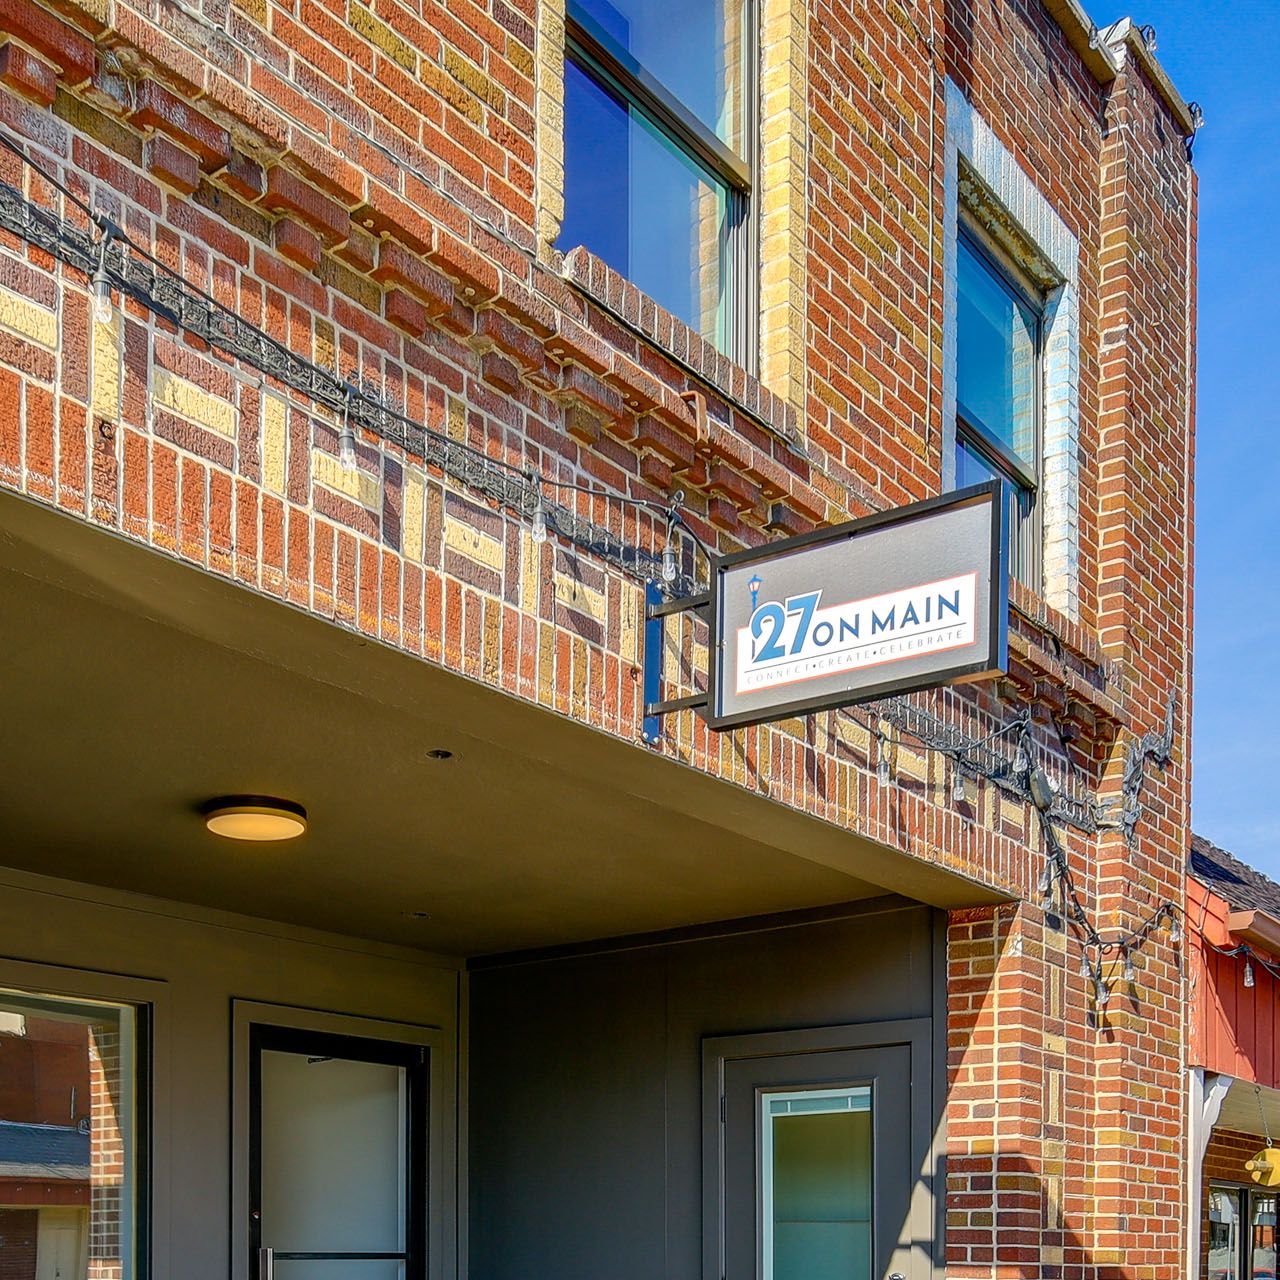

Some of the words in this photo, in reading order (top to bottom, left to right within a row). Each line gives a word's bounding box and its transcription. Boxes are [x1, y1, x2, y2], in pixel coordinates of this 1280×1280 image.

[751, 591, 821, 663] 27
[813, 613, 860, 647] ON
[871, 589, 960, 636] MAIN
